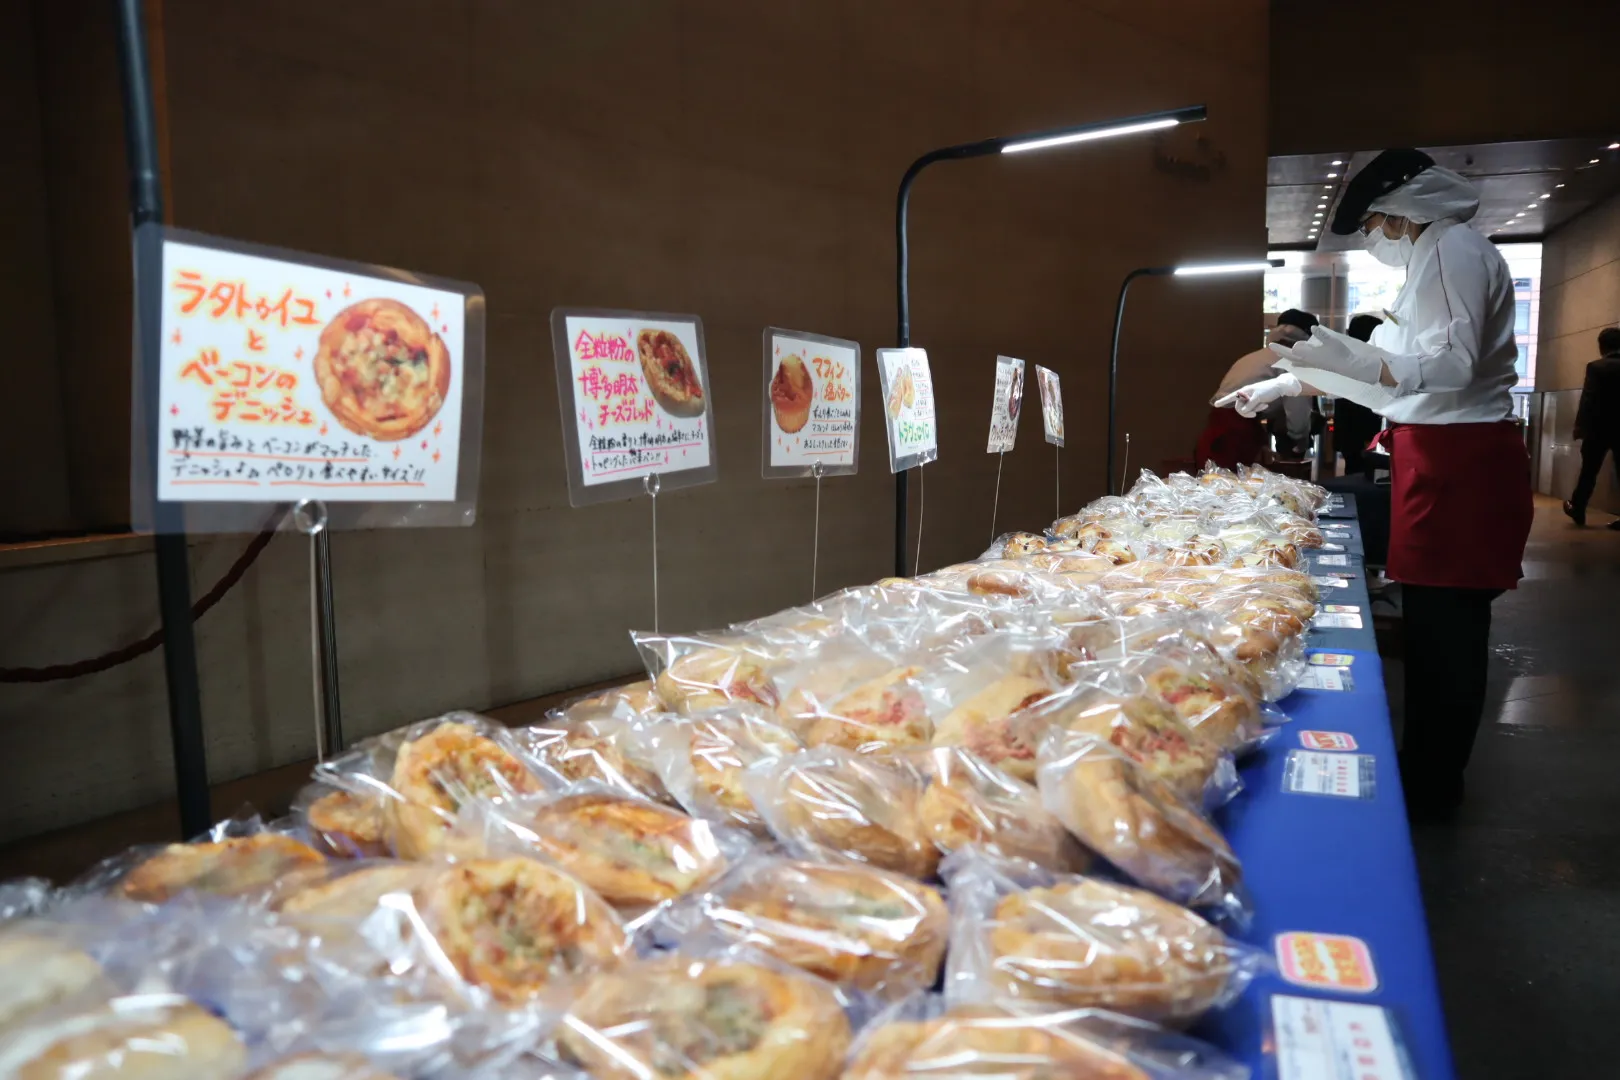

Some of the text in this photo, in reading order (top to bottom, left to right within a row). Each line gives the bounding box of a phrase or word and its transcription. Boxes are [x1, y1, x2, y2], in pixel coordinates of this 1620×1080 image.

[248, 330, 264, 351] と
[575, 329, 635, 362] 全粒粉の
[181, 350, 297, 389] ベーコンの
[578, 366, 639, 399] 博多明太
[212, 391, 314, 425] デニッシュ
[600, 398, 655, 425] チーズブレッド
